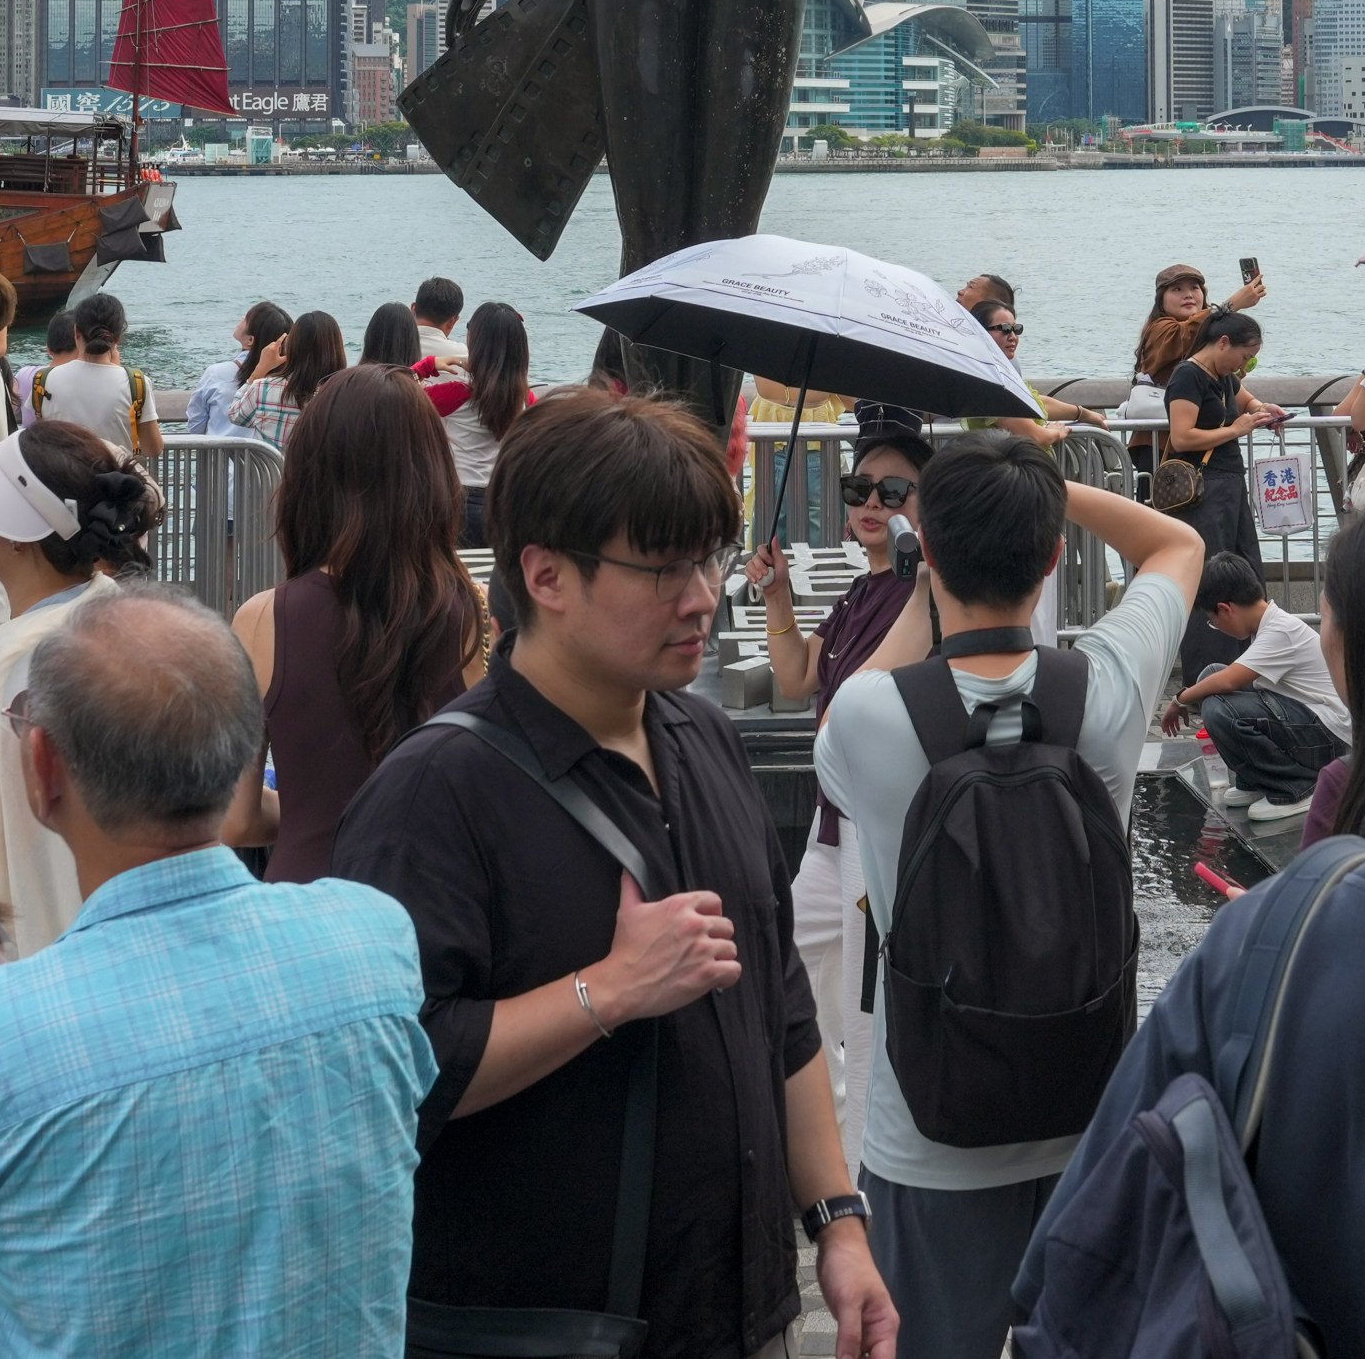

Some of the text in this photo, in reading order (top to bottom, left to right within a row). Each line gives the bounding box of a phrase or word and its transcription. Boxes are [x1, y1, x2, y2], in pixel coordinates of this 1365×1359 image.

[242, 91, 289, 115] Eagle
[291, 92, 329, 112] 鷹君
[722, 278, 752, 289] GRACE
[753, 284, 791, 296] BEAUTY
[880, 312, 909, 325] GRACE
[909, 322, 941, 336] BEAUTY
[1263, 467, 1297, 487] 香港
[1264, 485, 1299, 502] 紀念品
